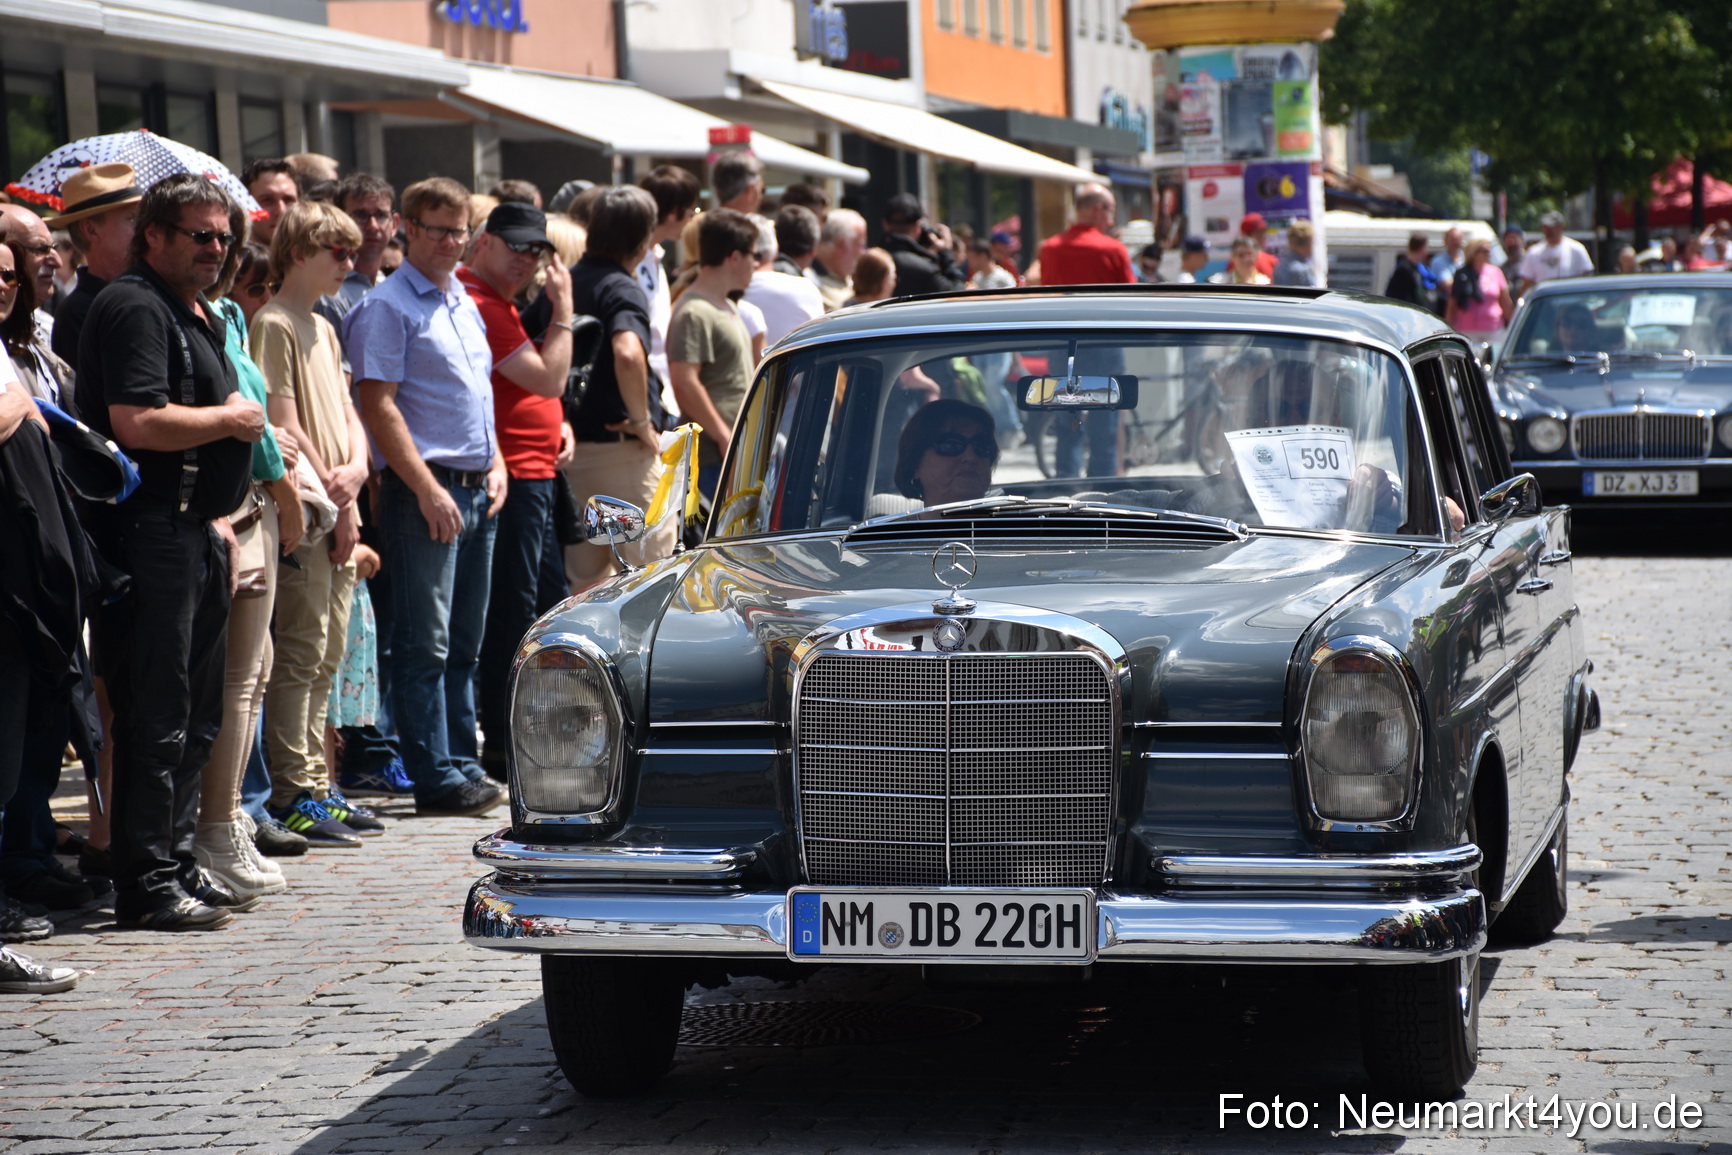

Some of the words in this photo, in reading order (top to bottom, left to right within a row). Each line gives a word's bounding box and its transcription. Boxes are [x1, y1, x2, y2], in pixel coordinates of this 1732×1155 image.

[1301, 447, 1339, 470] 590
[1602, 475, 1626, 492] DZ
[822, 901, 874, 946] NM
[909, 902, 961, 947] DB
[975, 902, 1081, 948] 220H
[802, 930, 812, 943] D
